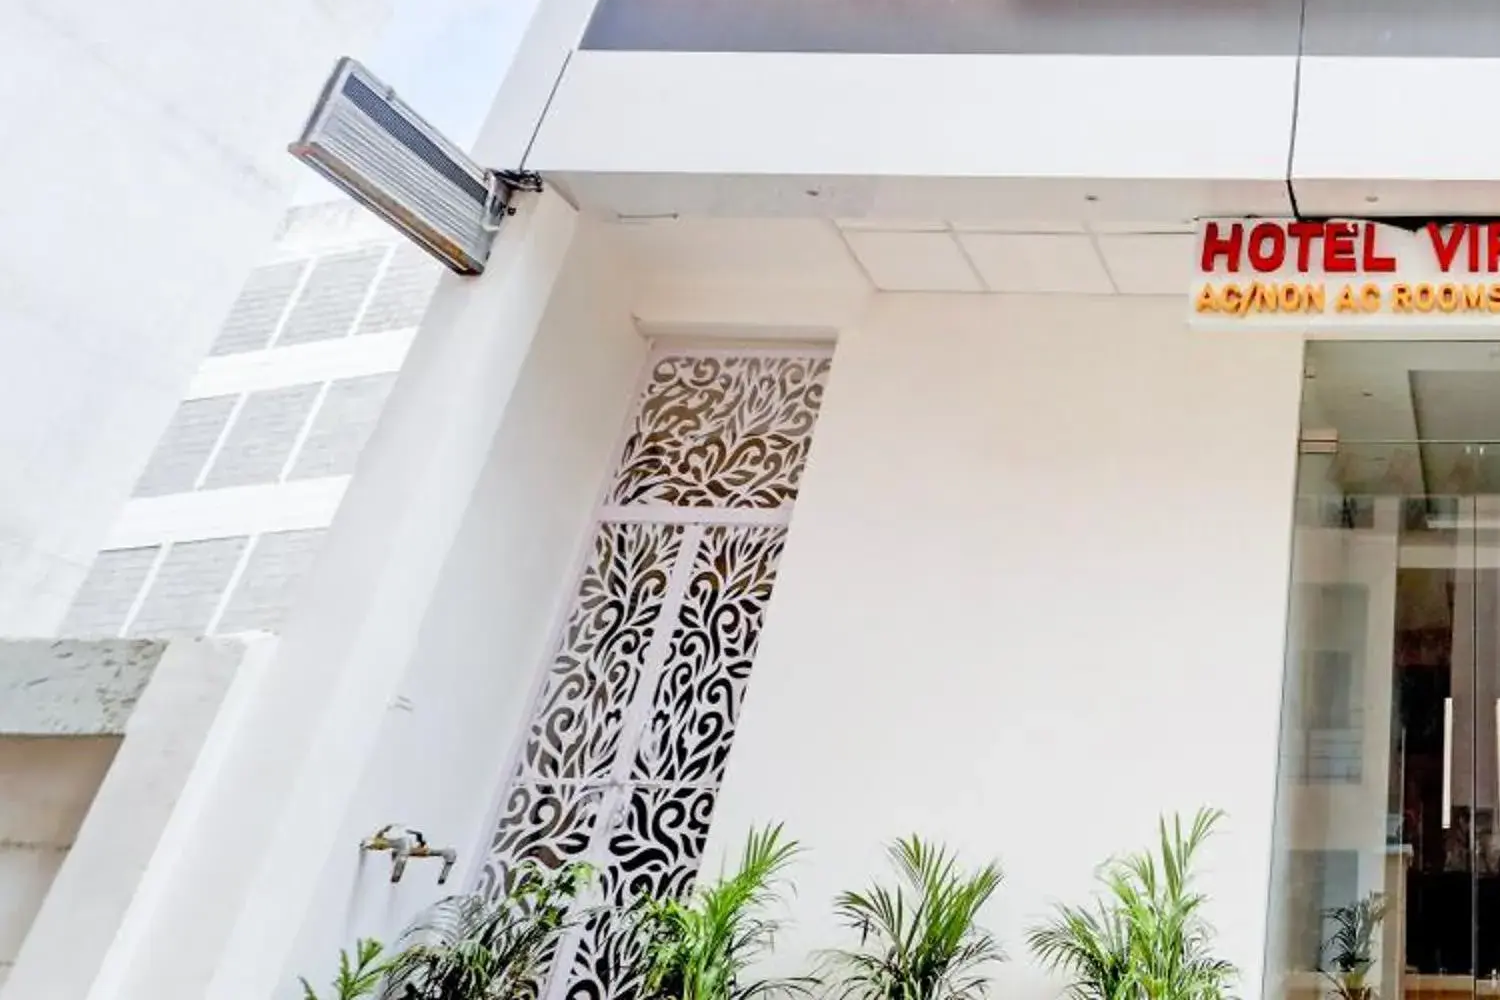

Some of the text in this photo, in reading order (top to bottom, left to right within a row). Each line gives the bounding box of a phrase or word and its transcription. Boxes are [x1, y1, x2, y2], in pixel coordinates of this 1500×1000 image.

[1201, 221, 1396, 272] HOTEL
[1195, 281, 1326, 317] AC/NON
[1336, 282, 1381, 314] AC
